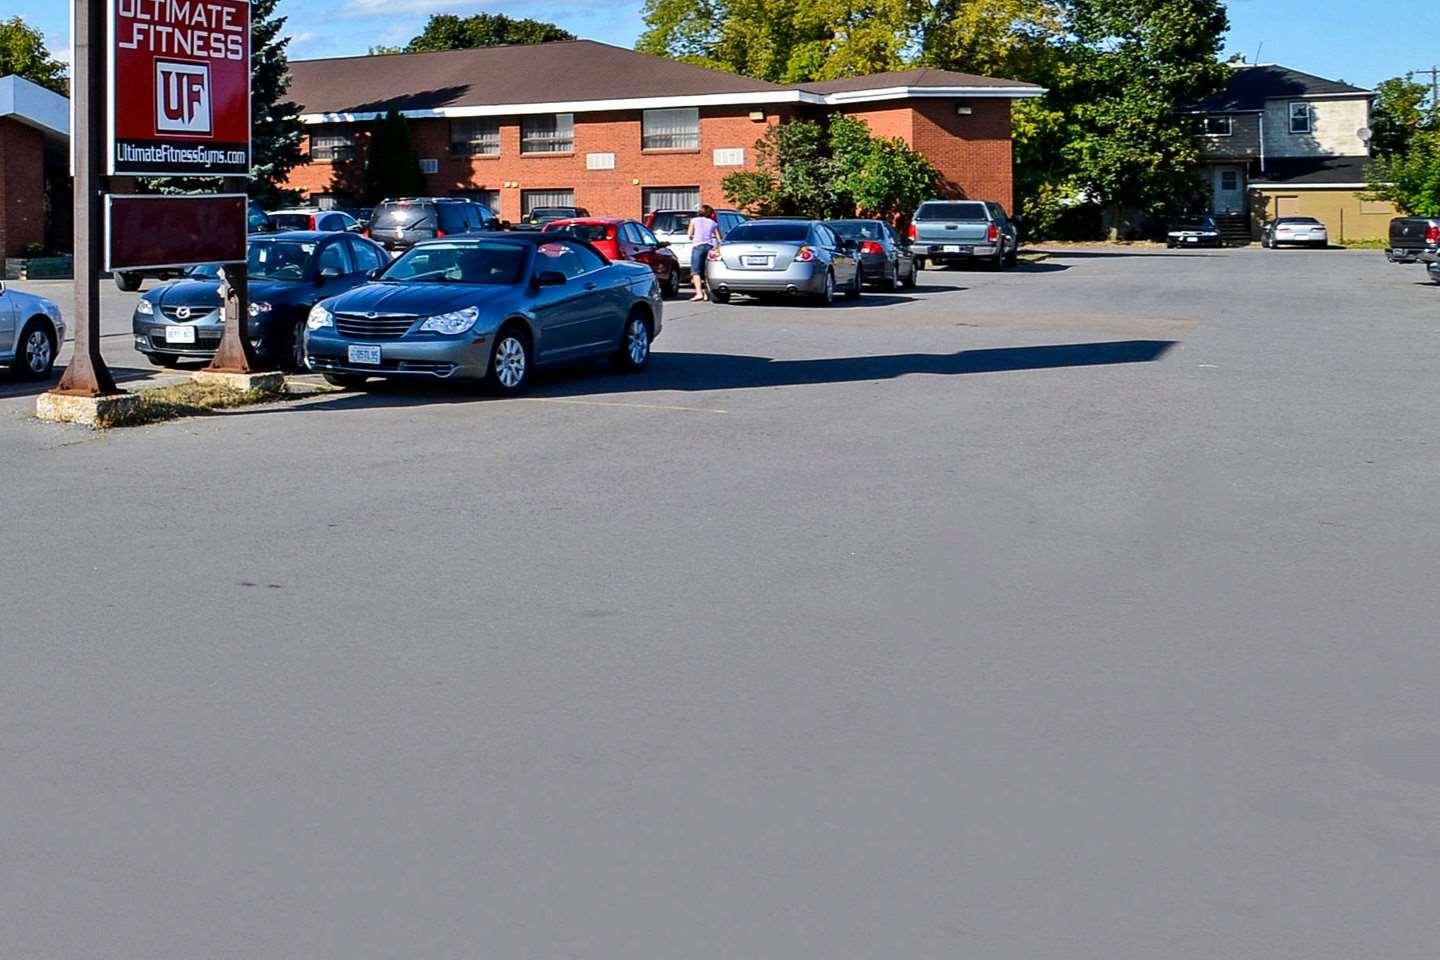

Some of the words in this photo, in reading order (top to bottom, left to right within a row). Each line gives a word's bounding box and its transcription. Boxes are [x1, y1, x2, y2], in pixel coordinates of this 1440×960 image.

[118, 23, 243, 61] FITNESS
[160, 69, 206, 125] UF
[117, 142, 245, 167] UltimateFitnessGyms.com
